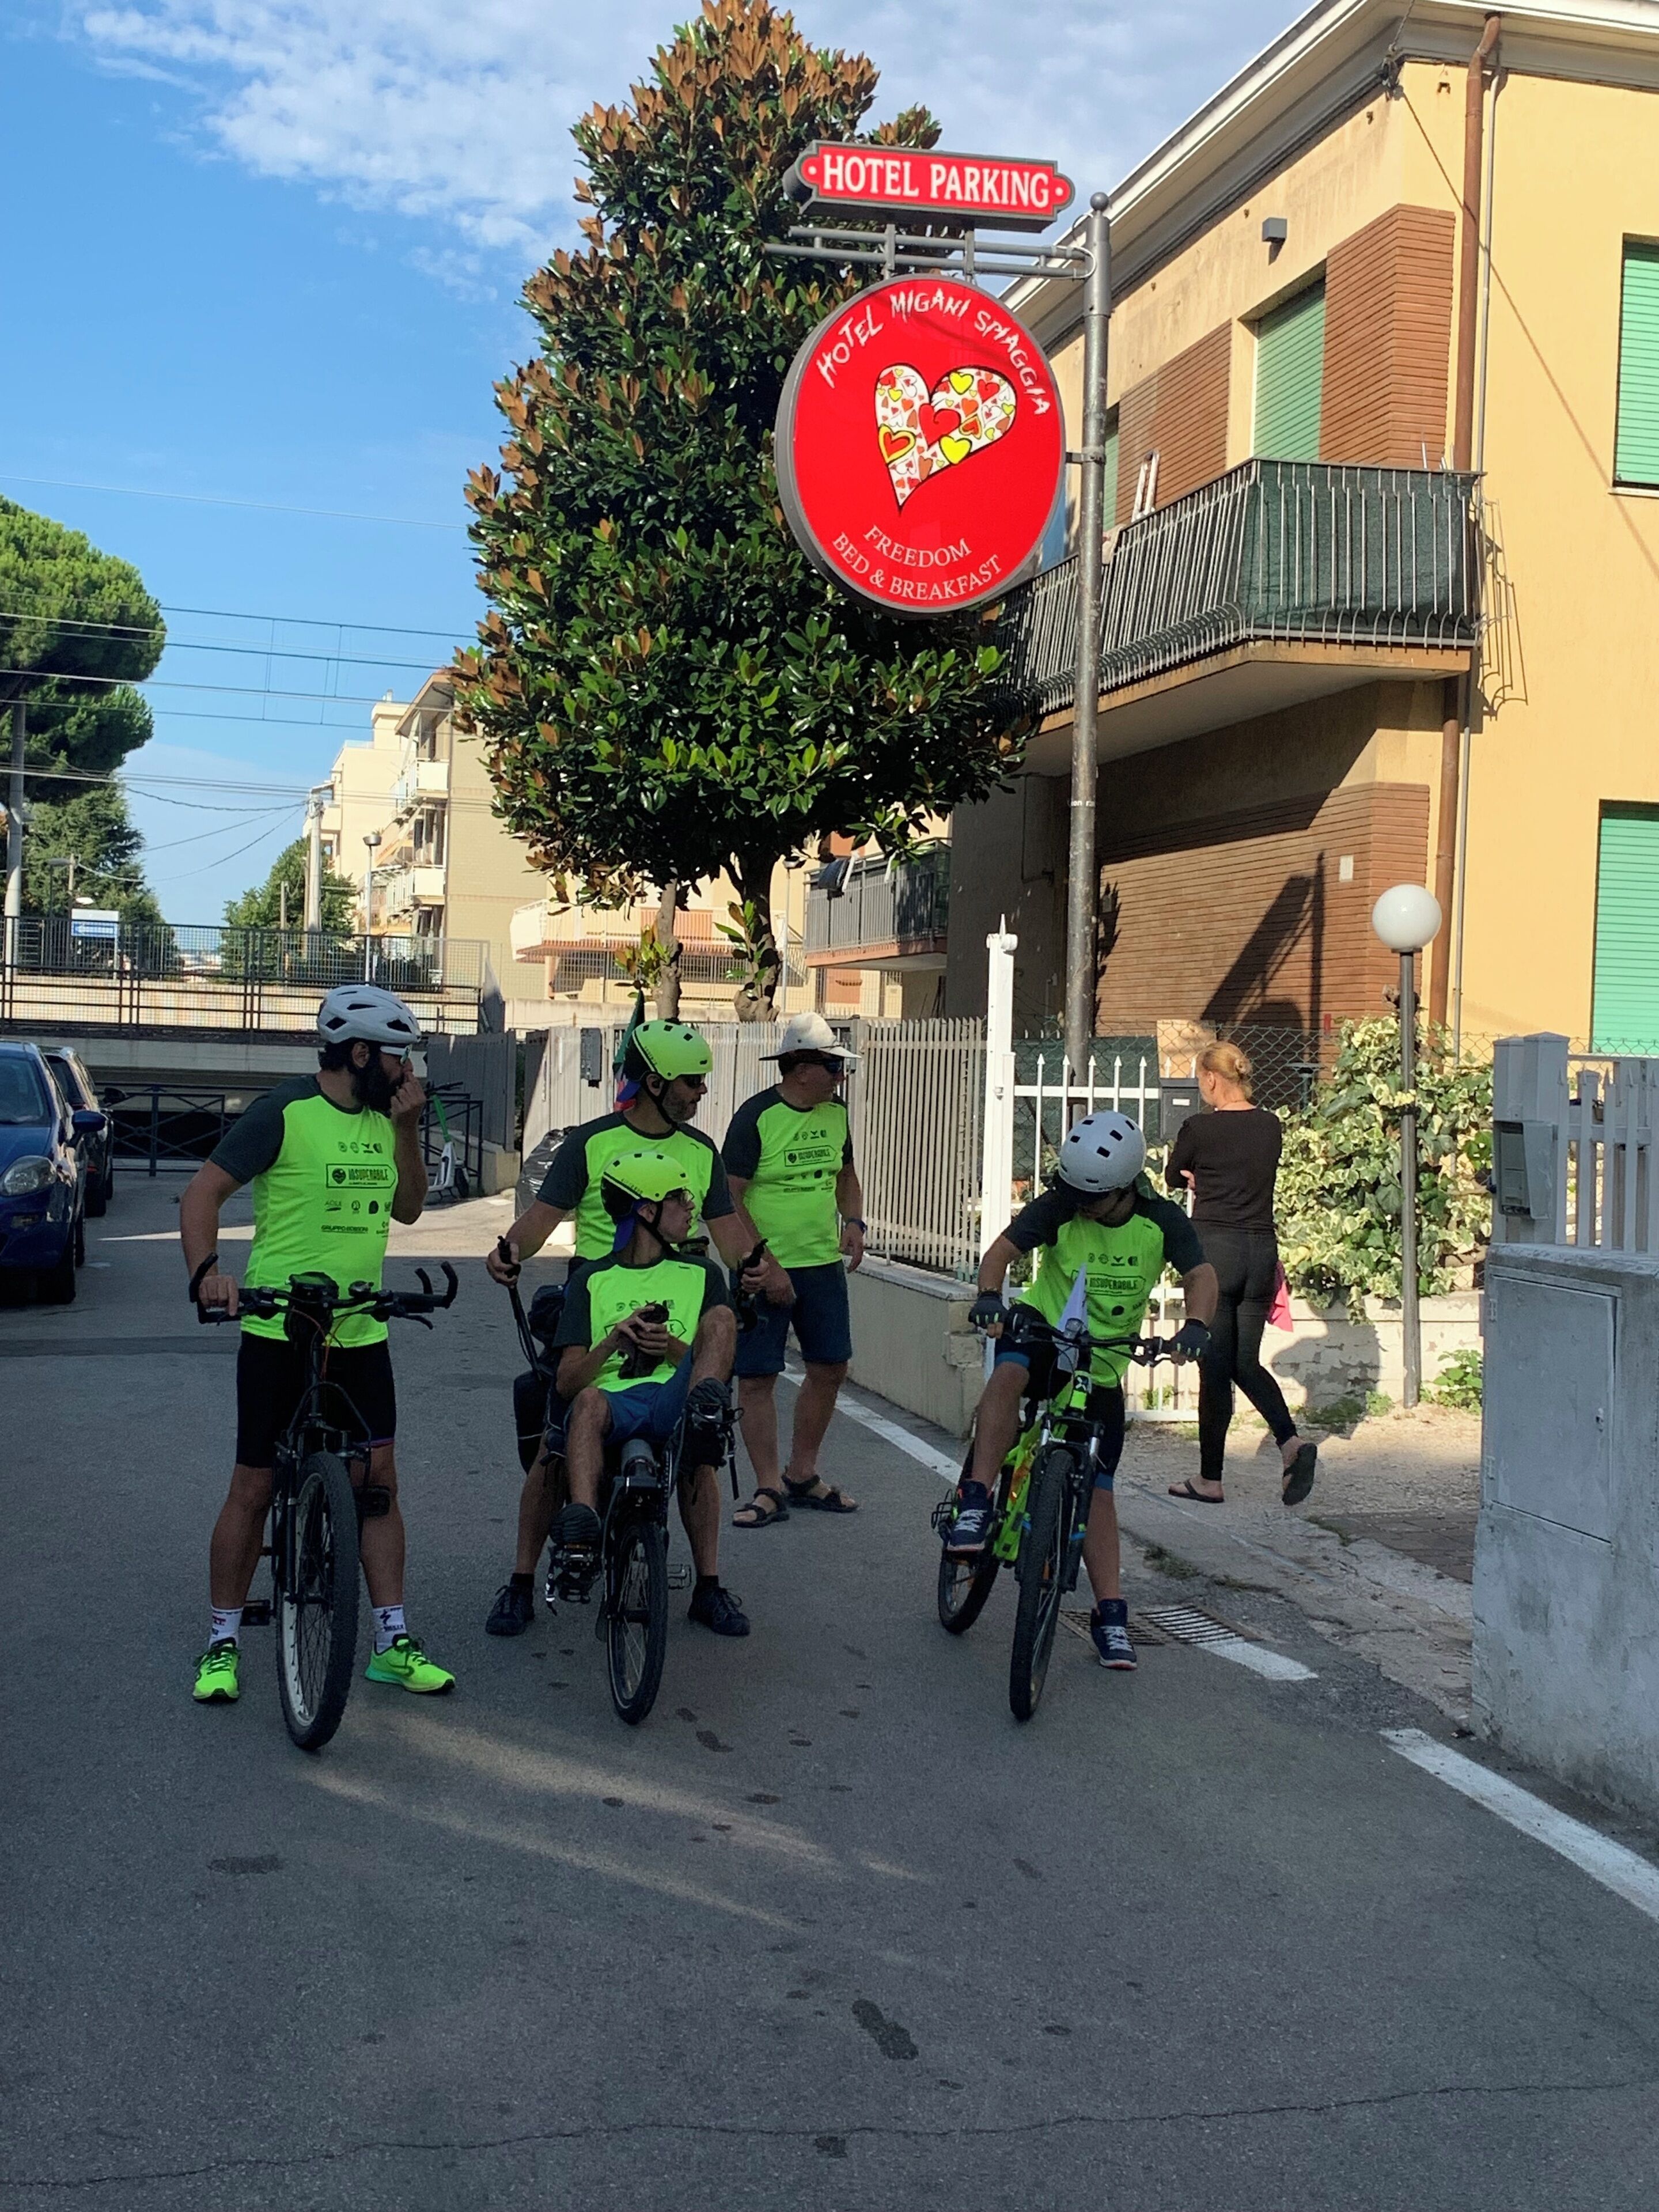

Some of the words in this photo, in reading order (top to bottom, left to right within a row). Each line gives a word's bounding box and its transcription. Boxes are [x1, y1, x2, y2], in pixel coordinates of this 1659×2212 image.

[823, 154, 919, 196] HOTEL
[930, 164, 1049, 208] PARKING
[816, 305, 884, 389] HOTEL
[889, 287, 971, 323] MIGANI
[974, 310, 1051, 415] SPIAGGIA
[832, 532, 870, 574] BED
[869, 569, 885, 588] &
[889, 554, 1002, 600] BREAKFAST
[863, 525, 972, 568] FREEDOM
